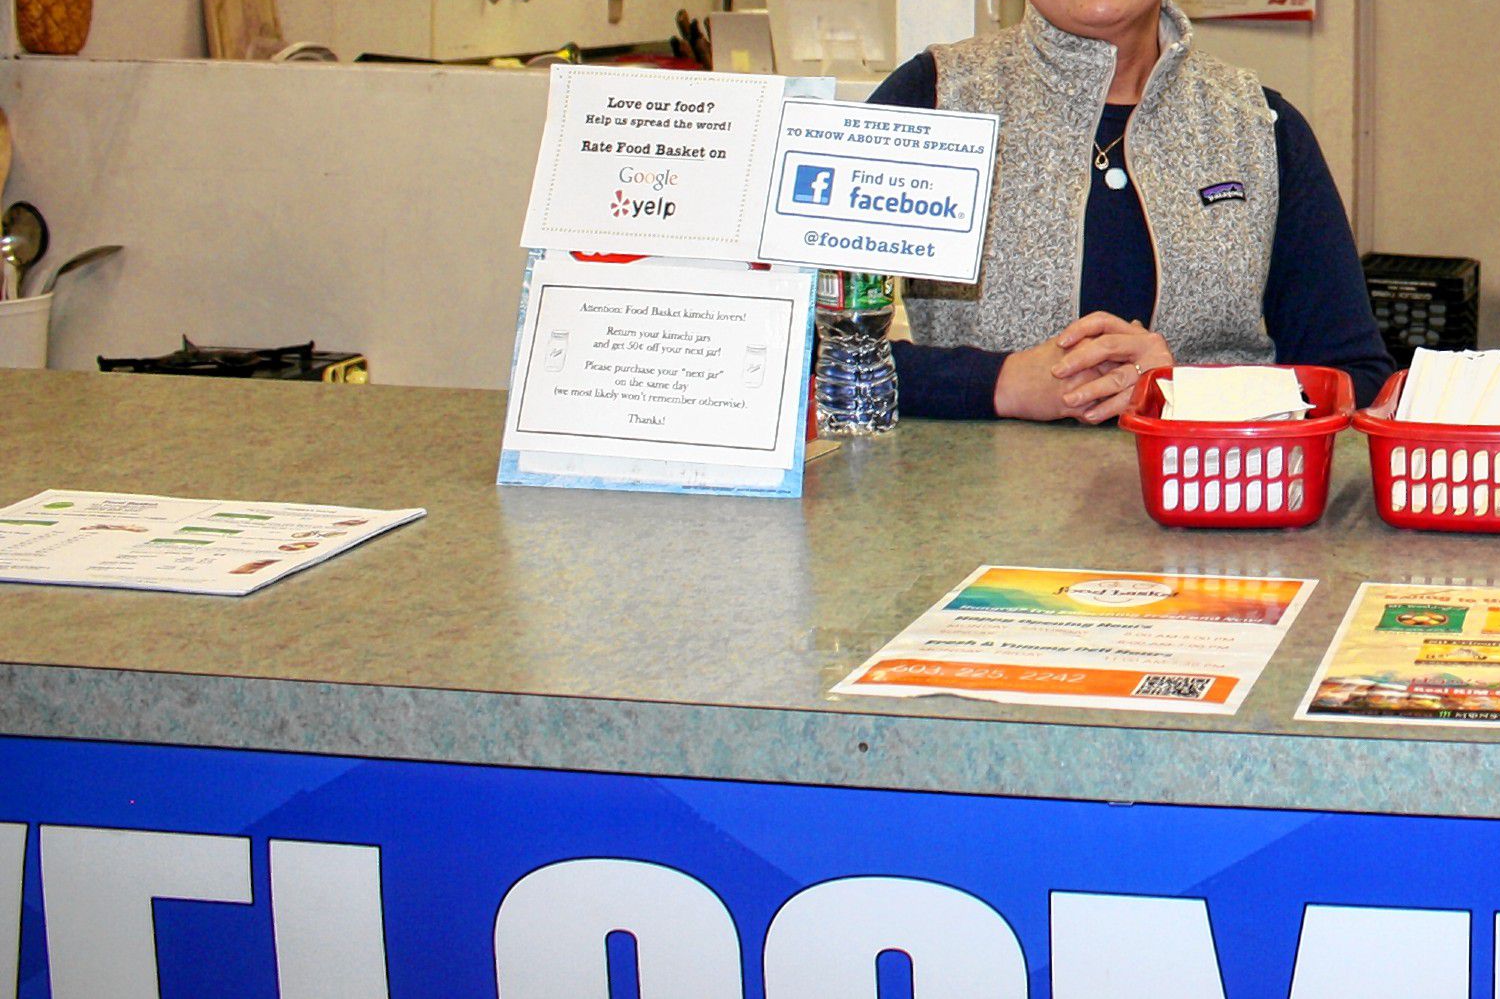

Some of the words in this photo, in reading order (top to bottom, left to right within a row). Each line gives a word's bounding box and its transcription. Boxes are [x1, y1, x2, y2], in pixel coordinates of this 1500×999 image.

[607, 96, 642, 110] Love
[646, 100, 671, 111] our
[674, 100, 715, 113] food?
[585, 114, 612, 126] Help
[615, 117, 627, 126] us
[630, 117, 670, 129] spread
[674, 119, 693, 129] the
[696, 121, 732, 131] word!
[843, 118, 860, 128] BE
[864, 120, 890, 130] THE
[893, 122, 931, 135] FIRST
[581, 140, 613, 153] Rate
[615, 142, 651, 155] Food
[655, 144, 705, 158] Basket
[709, 149, 727, 159] on
[786, 127, 802, 137] TO
[804, 129, 844, 141] KNOW
[847, 133, 891, 146] ABOUT
[894, 137, 920, 148] OUR
[923, 140, 985, 155] SPECIALS
[619, 166, 679, 191] Google
[851, 169, 884, 186] Find
[889, 175, 905, 187] us
[910, 177, 934, 191] on:
[631, 196, 676, 220] yelp
[849, 186, 959, 220] facebook
[804, 230, 936, 258] @foodbasket
[628, 413, 666, 427] Thanks!
[1019, 670, 1087, 684] 2242
